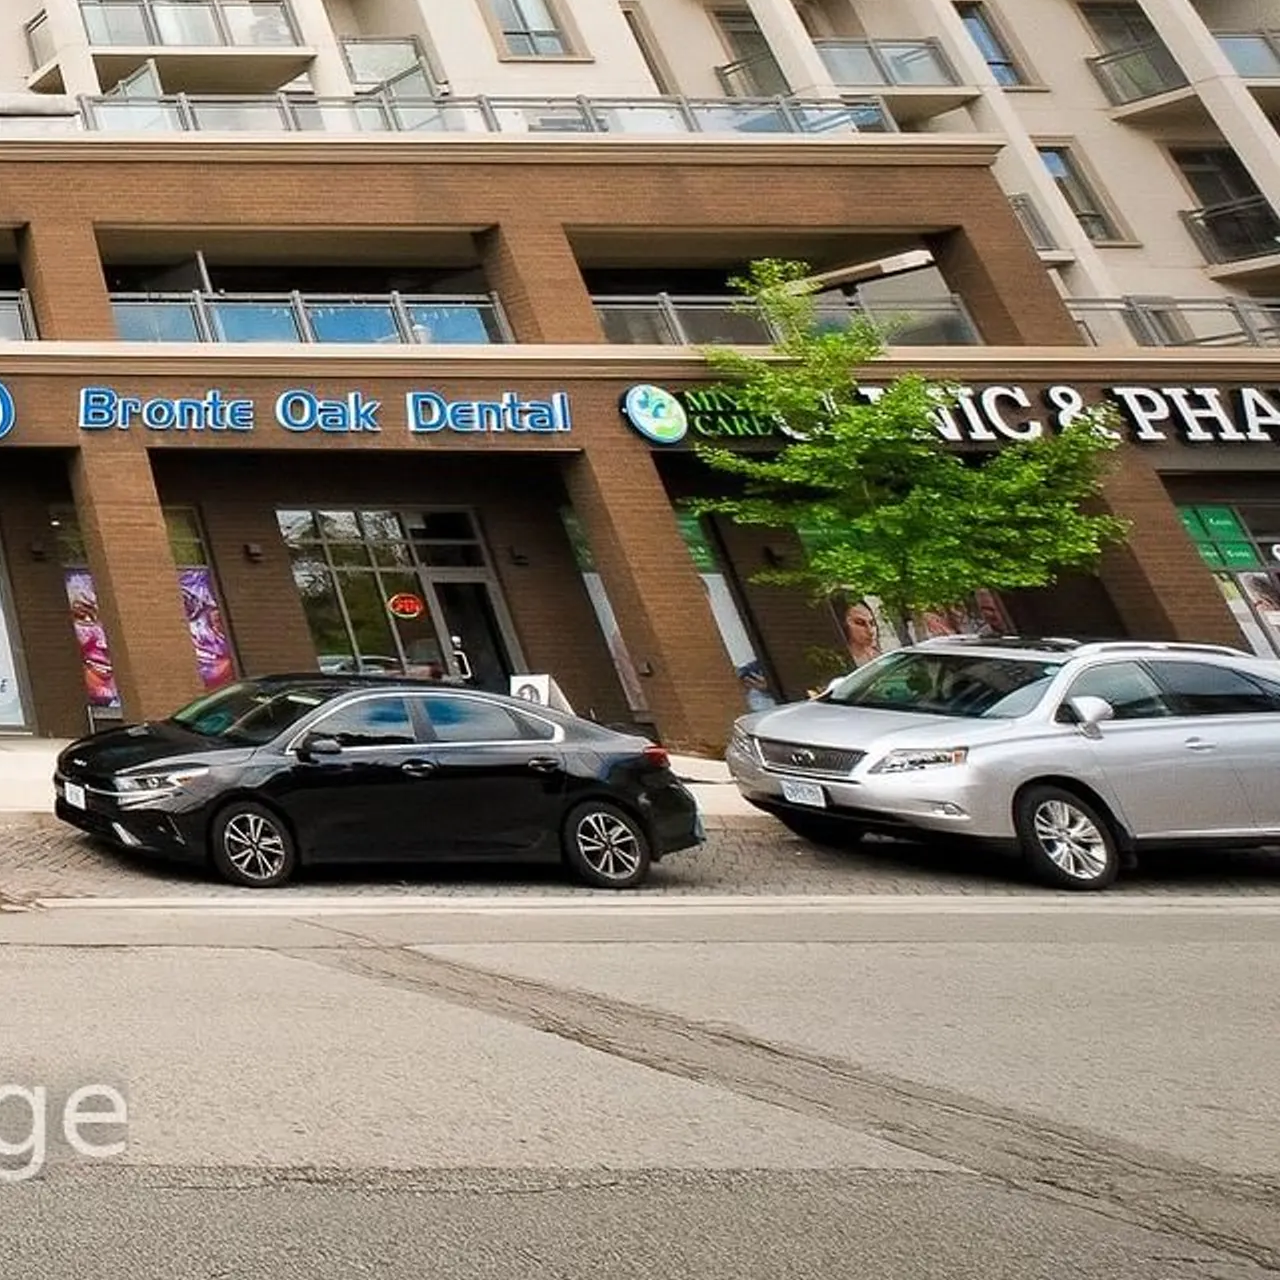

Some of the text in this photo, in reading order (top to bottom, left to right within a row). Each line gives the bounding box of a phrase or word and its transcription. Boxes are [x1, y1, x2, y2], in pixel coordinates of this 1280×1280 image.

[79, 387, 572, 432] Bronte Oak Dental
[694, 415, 776, 436] CARE
